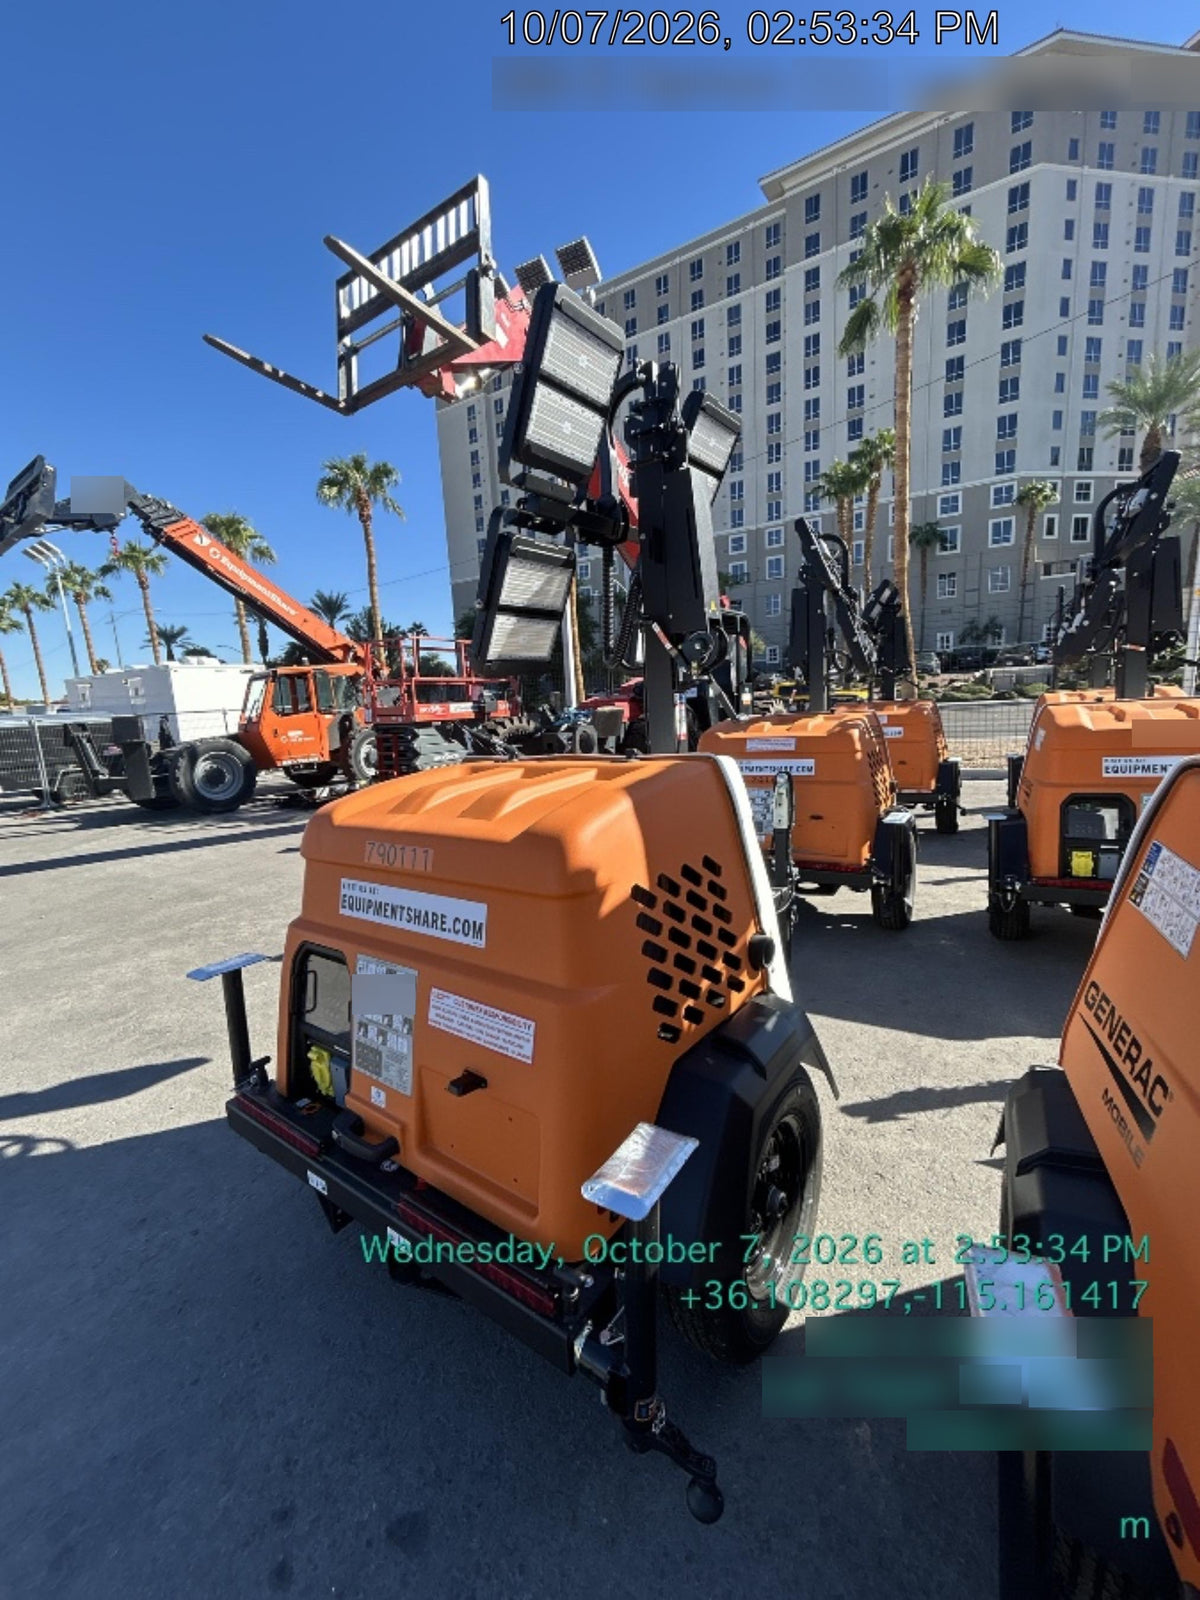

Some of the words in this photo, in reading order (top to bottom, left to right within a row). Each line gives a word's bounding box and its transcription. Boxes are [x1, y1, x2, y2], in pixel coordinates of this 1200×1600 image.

[366, 841, 430, 872] 790111
[340, 893, 484, 941] EQUIPMENTSHARE.COM
[1083, 980, 1169, 1118] GENERAC
[1102, 1087, 1146, 1170] MOBILE
